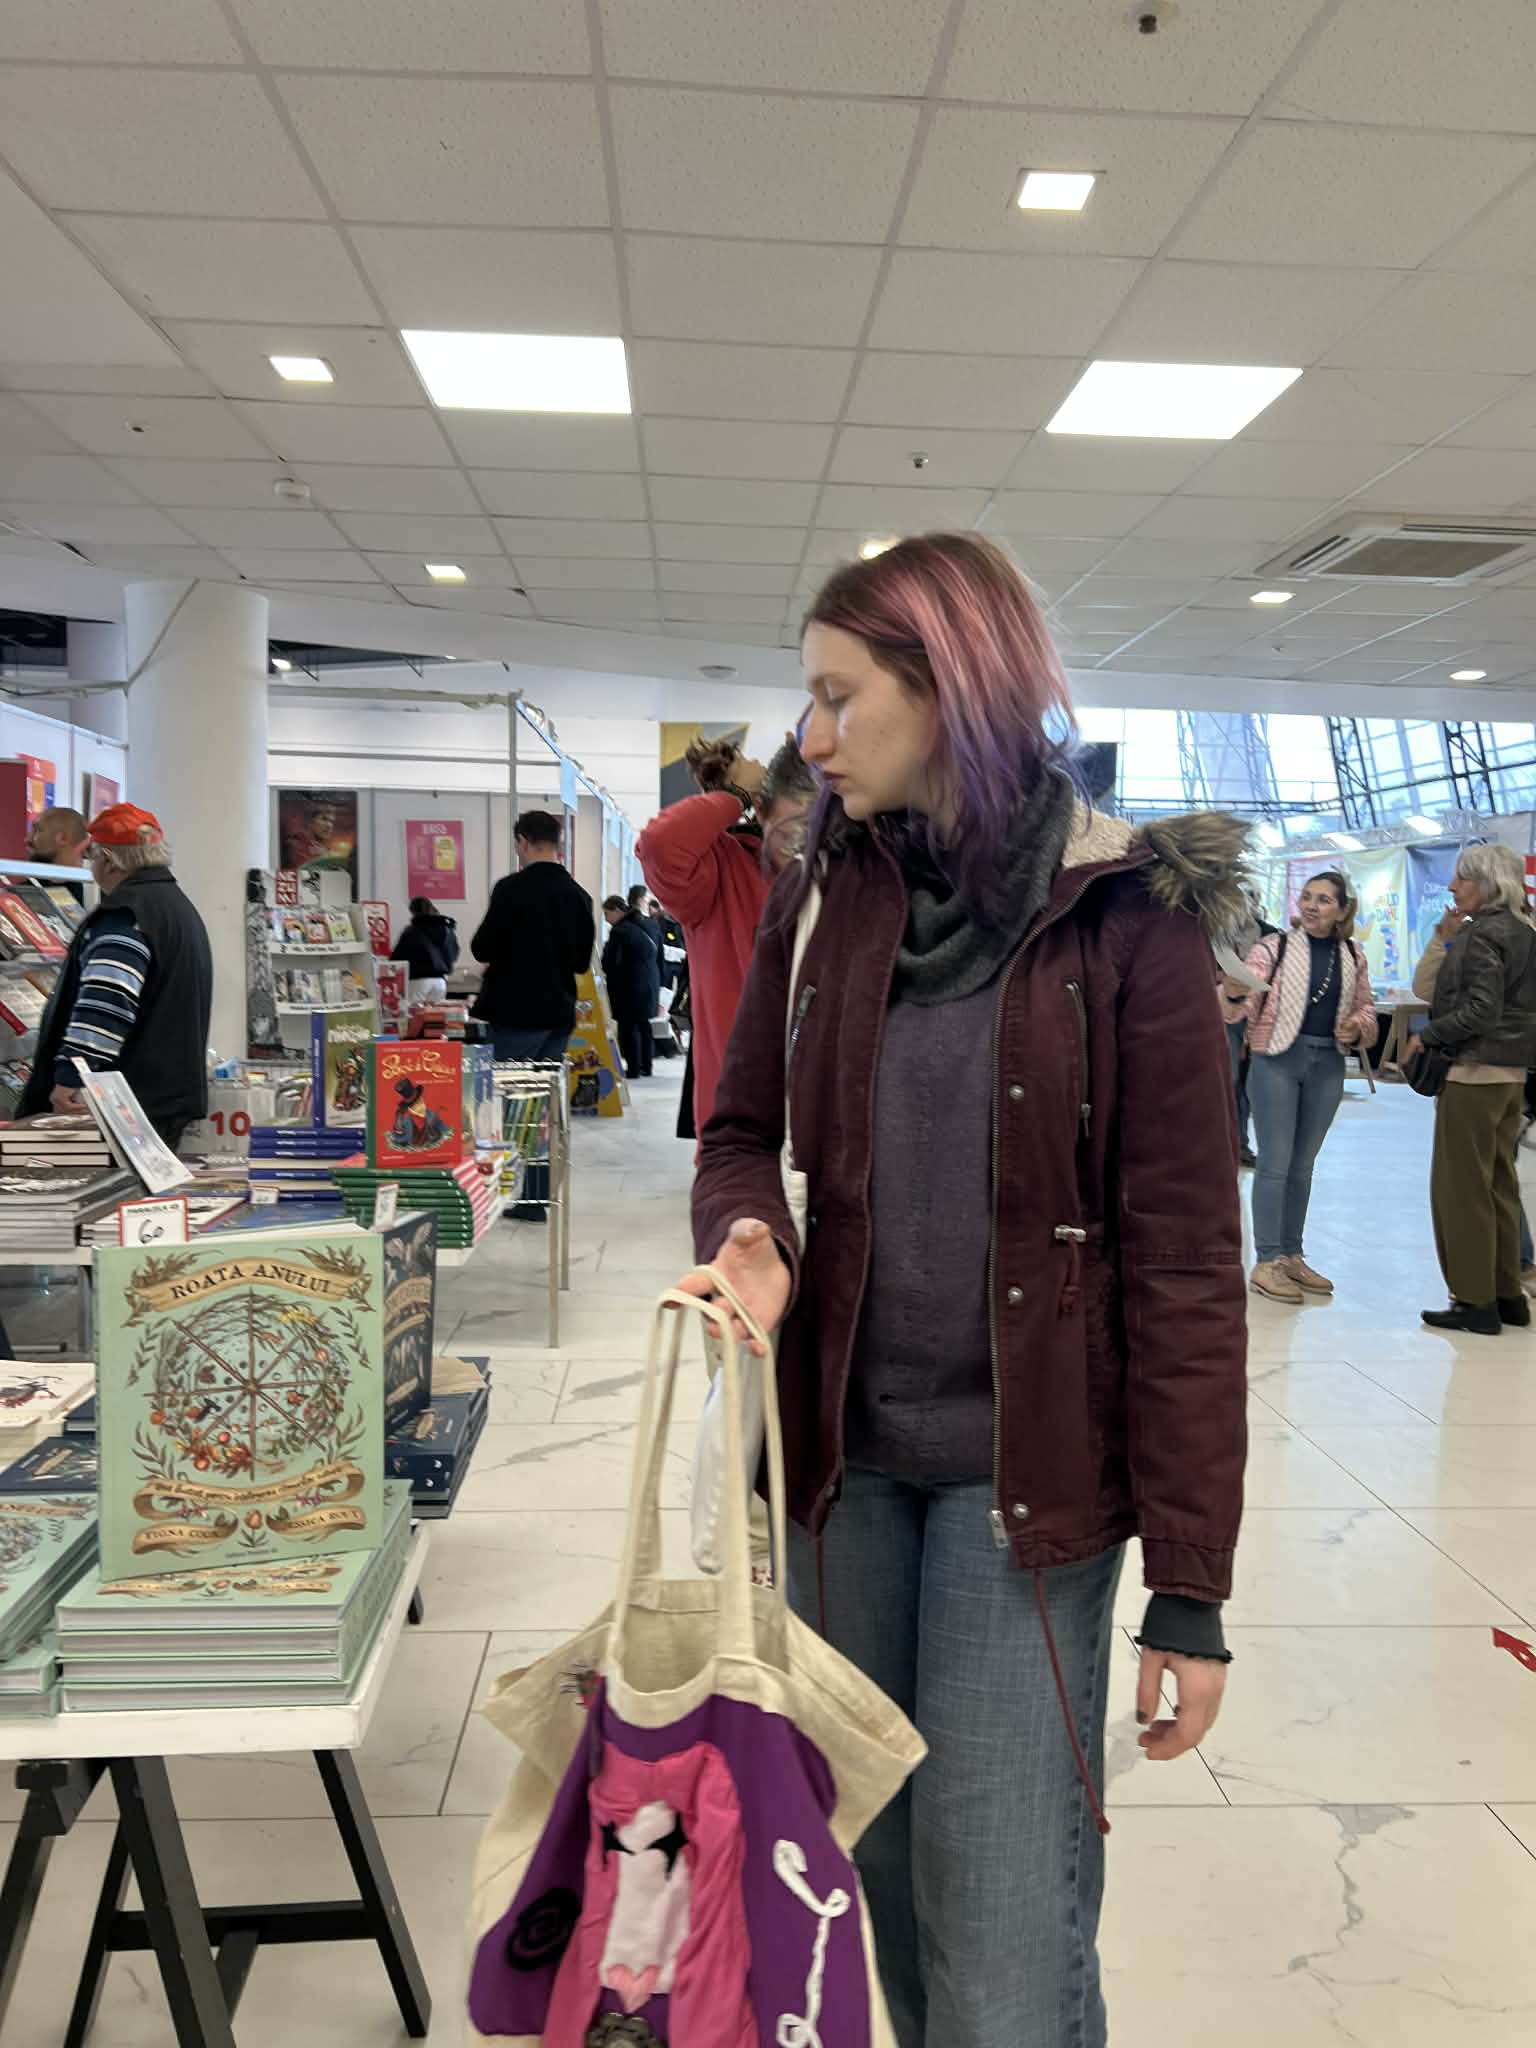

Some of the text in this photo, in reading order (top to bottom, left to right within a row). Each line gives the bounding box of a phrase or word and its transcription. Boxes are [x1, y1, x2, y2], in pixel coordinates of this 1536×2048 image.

[209, 1111, 251, 1136] 10
[170, 1263, 332, 1299] ROATA ANULUI
